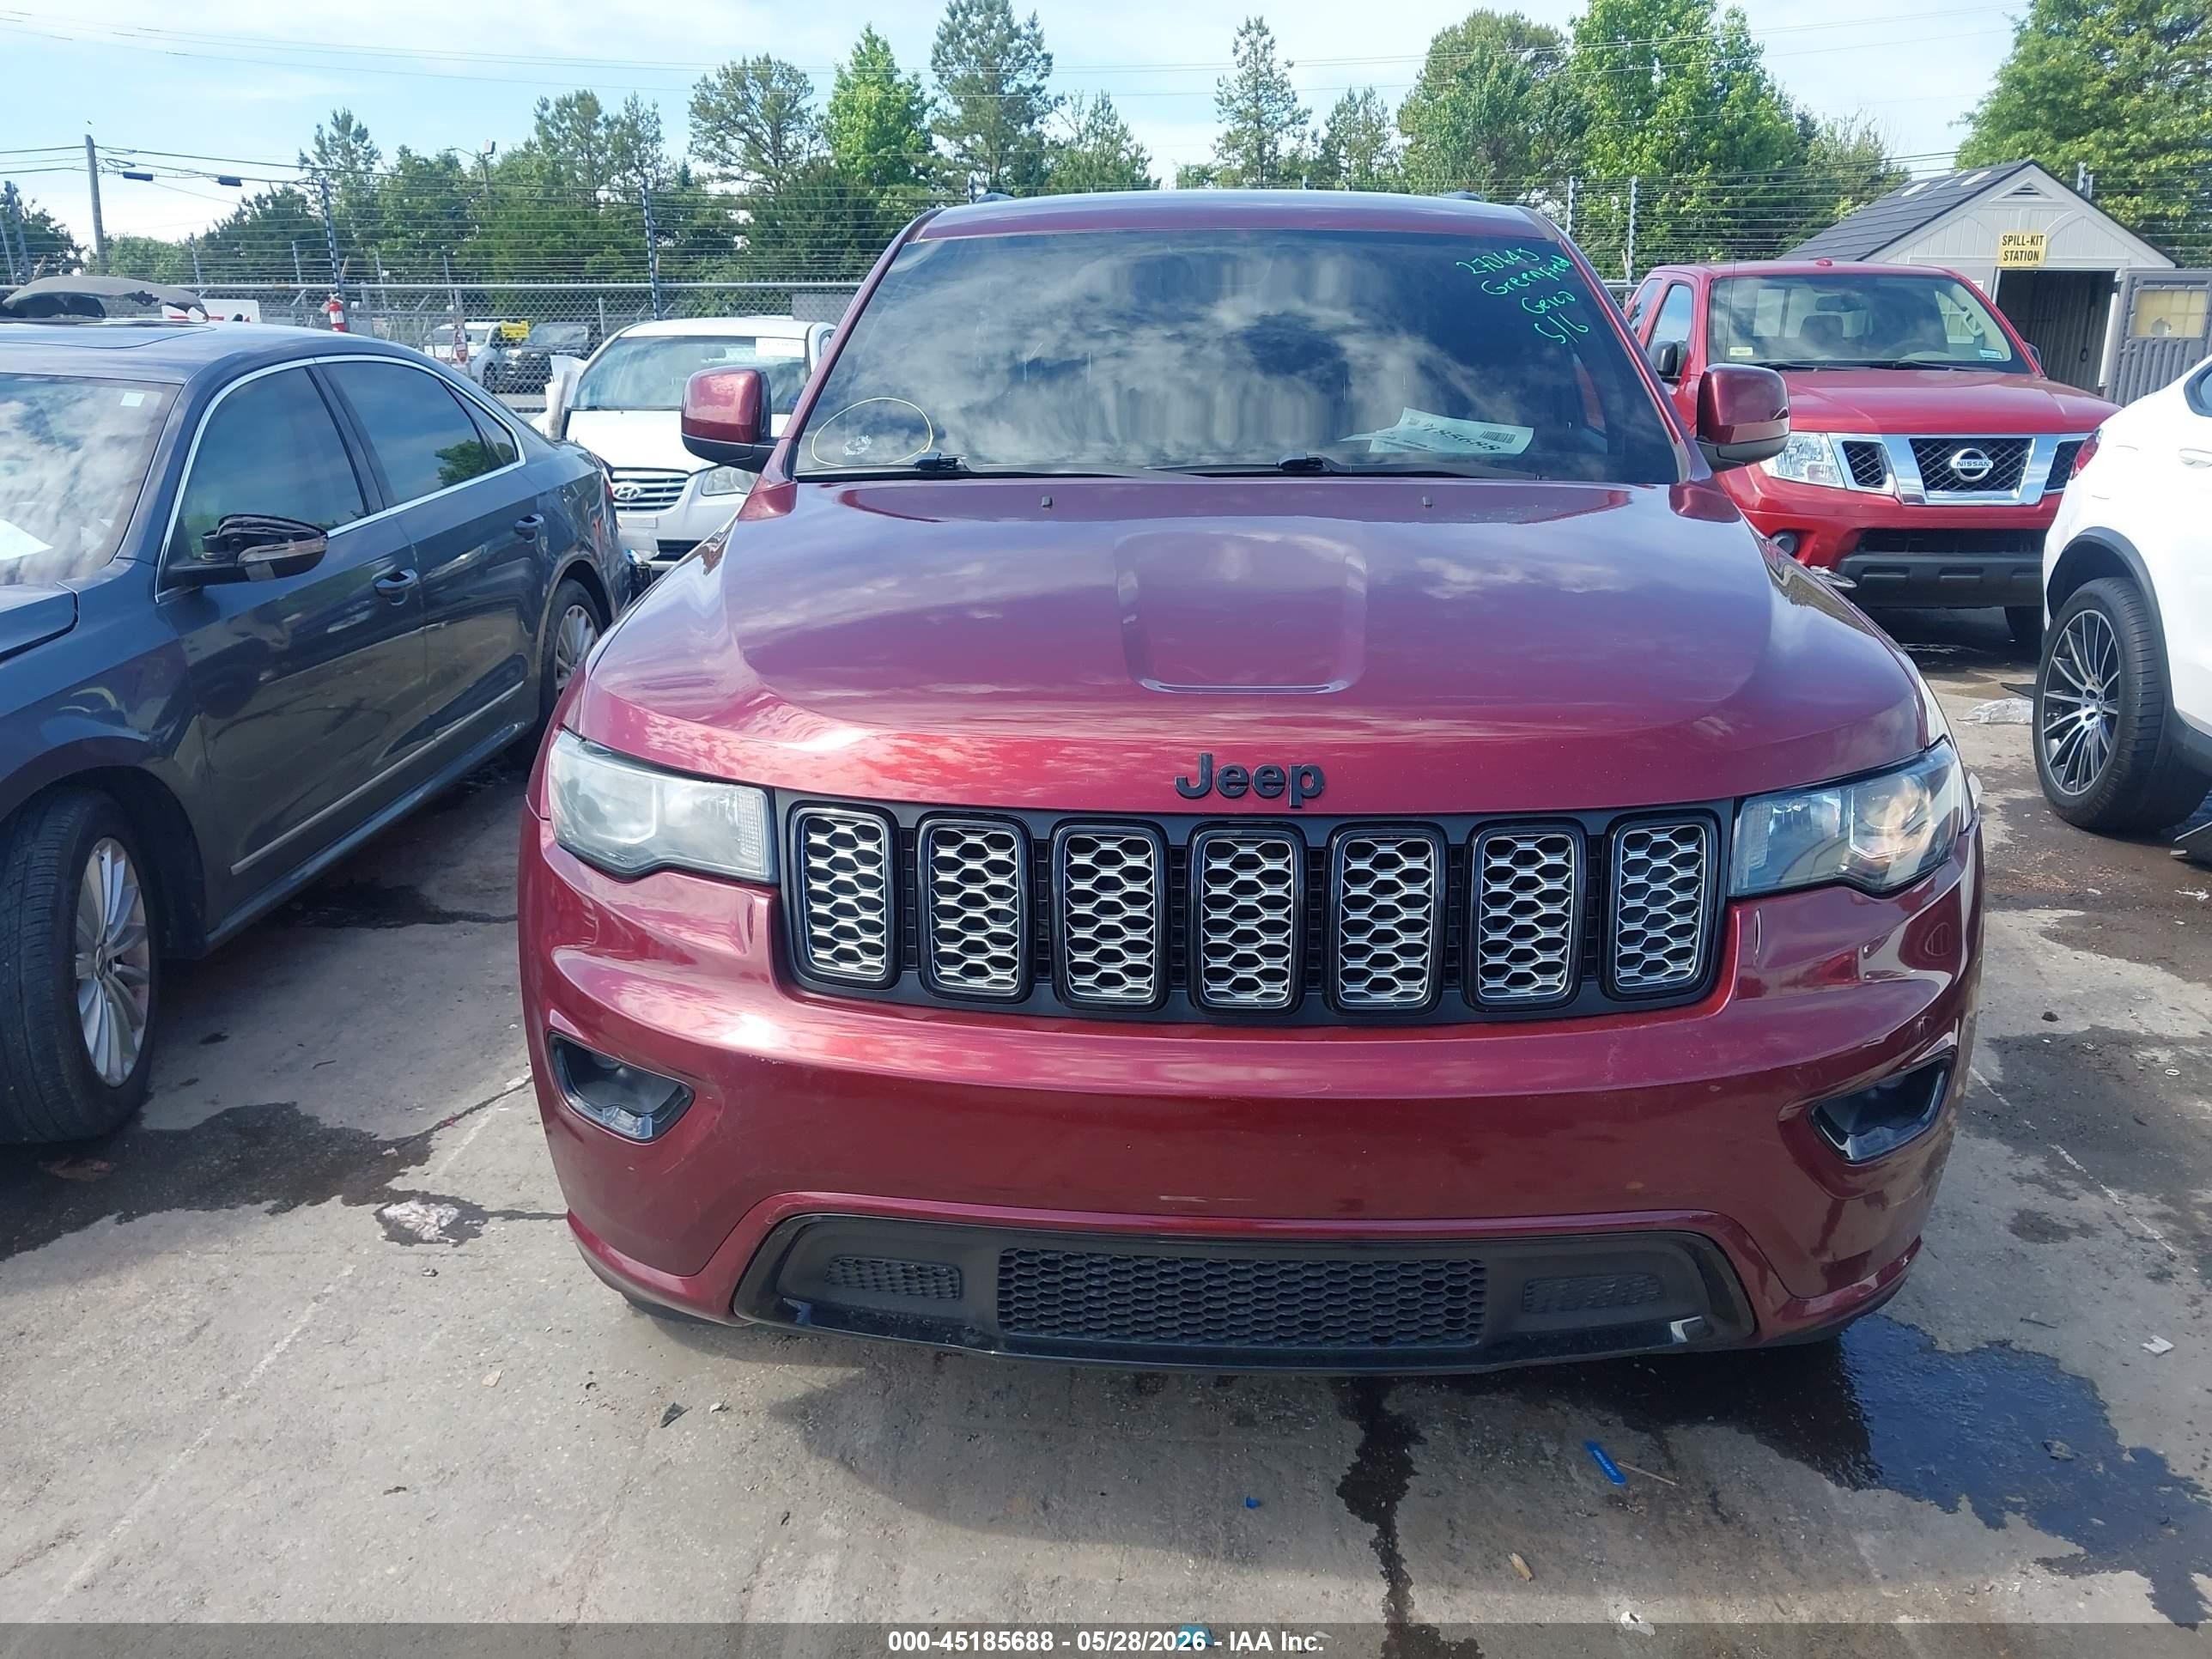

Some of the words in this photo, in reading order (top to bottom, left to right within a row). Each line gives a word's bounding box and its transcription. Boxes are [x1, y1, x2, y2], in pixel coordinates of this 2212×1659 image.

[2002, 234, 2045, 246] SPILL-KIT
[2002, 250, 2040, 262] STATION
[1480, 254, 1574, 295] Greenfield
[1175, 751, 1325, 809] Jeep
